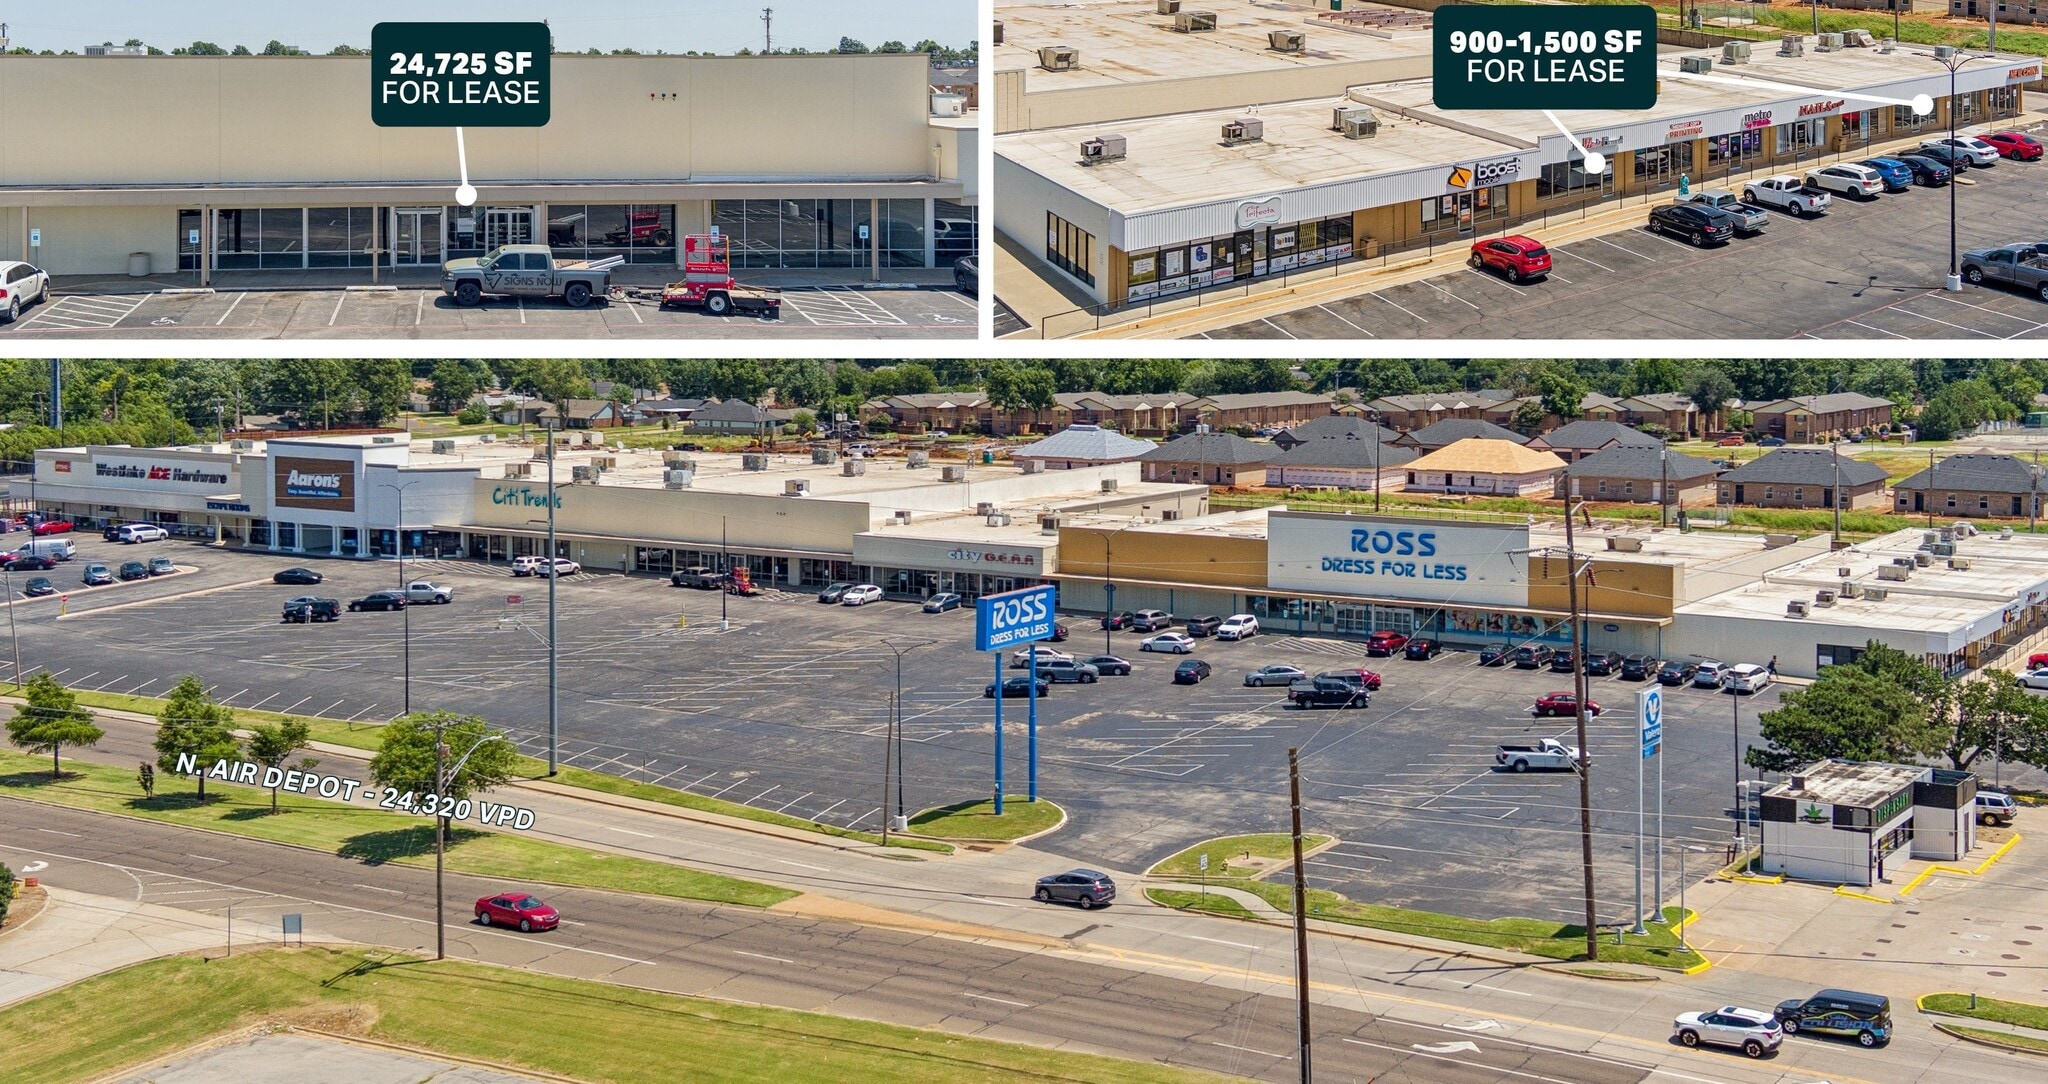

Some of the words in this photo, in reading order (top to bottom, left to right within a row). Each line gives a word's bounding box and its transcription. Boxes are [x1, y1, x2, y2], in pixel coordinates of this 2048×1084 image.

[1744, 110, 1772, 121] metro
[1669, 127, 1703, 138] PRINTING
[1476, 160, 1520, 178] boost
[1477, 176, 1501, 186] mobile
[503, 276, 534, 286] SIGNS
[96, 463, 146, 479] Westlake
[148, 465, 171, 480] ACE
[173, 468, 228, 484] Hardware
[286, 469, 340, 488] Aaron's
[493, 487, 519, 505] Citi
[1351, 528, 1436, 557] ROSS
[947, 547, 982, 563] city
[1321, 557, 1375, 575] DRESS
[1381, 561, 1416, 577] FOR
[1423, 564, 1467, 581] LESS
[992, 592, 1047, 630] ROSS
[990, 631, 1013, 645] DRESS
[1014, 627, 1029, 639] FOR
[1030, 623, 1049, 636] LESS
